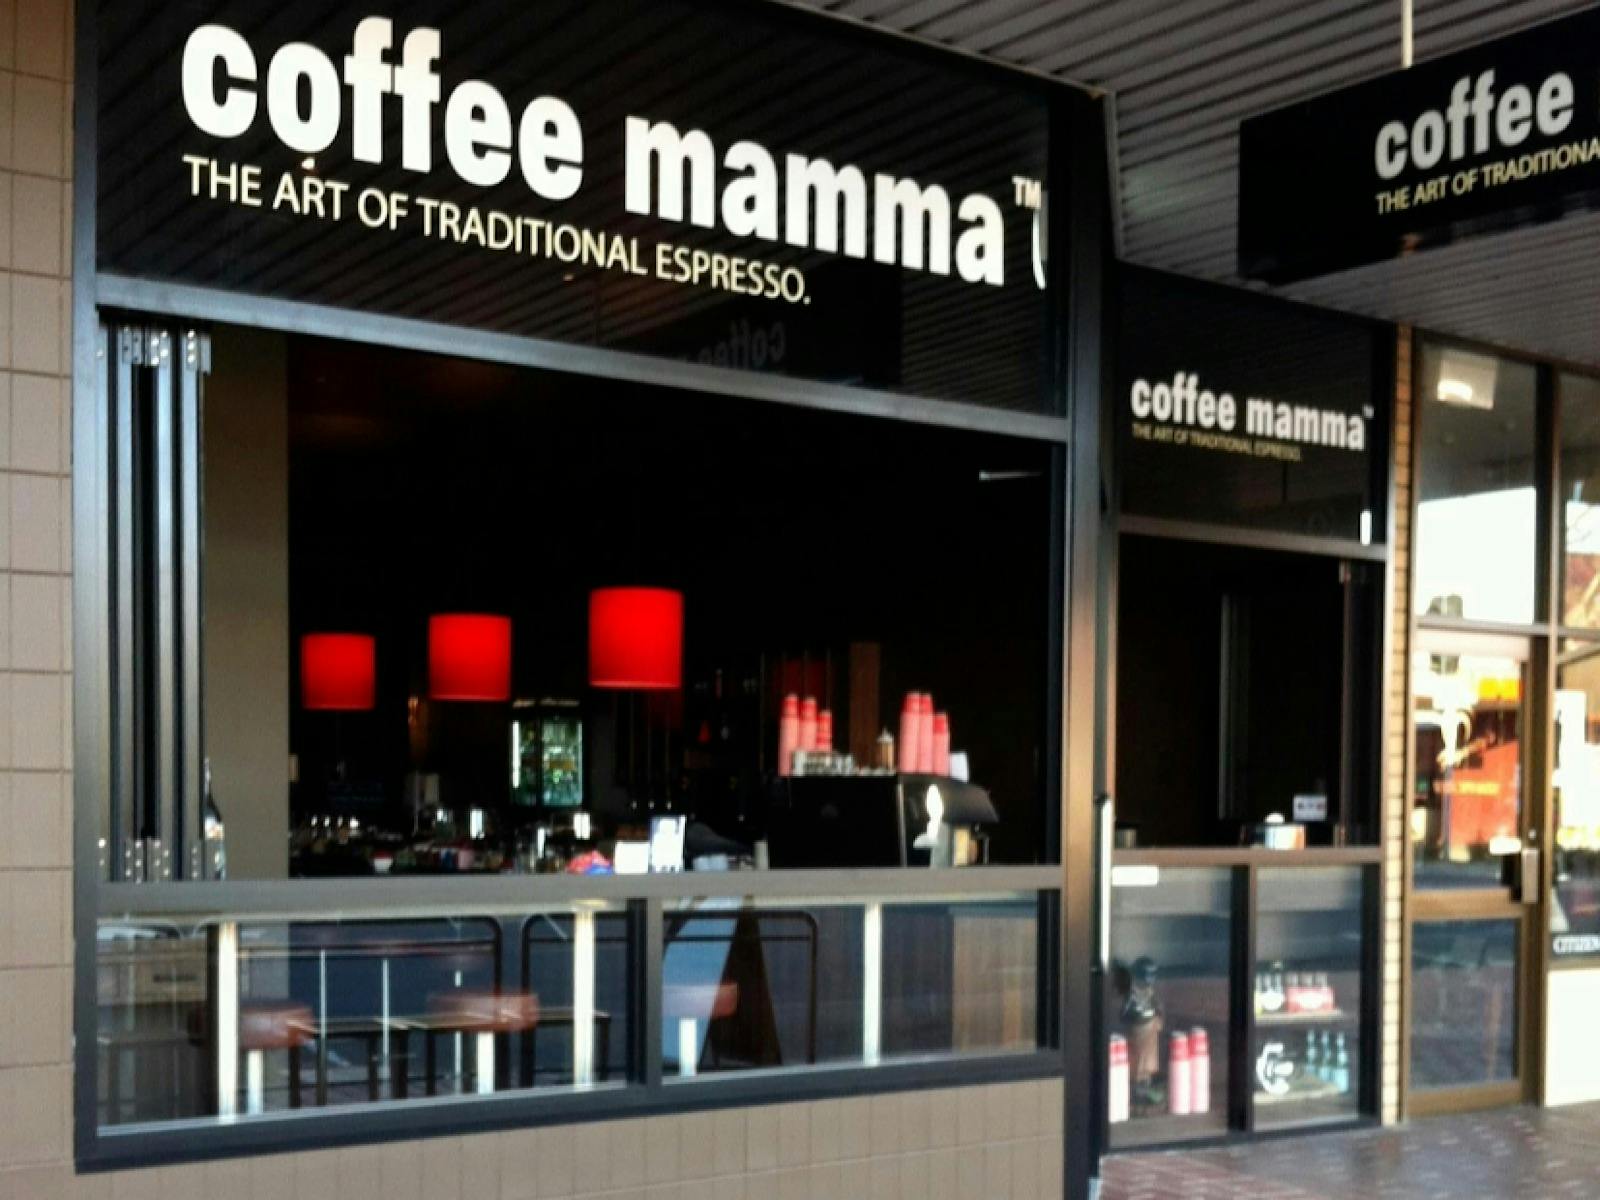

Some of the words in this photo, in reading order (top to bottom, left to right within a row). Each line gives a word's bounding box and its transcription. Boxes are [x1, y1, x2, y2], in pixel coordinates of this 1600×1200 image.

[181, 15, 584, 200] coffee
[625, 115, 1005, 286] mamma
[1374, 67, 1575, 180] coffee
[182, 154, 263, 207] THE
[272, 172, 349, 221] ART
[357, 187, 409, 231] OF
[415, 197, 648, 276] TRADITIONAL
[654, 243, 812, 305] ESPRESSO.
[1374, 186, 1411, 215] THE
[1414, 175, 1450, 206] ART
[1452, 167, 1479, 196] OF
[1131, 370, 1237, 431] coffee
[1245, 397, 1365, 451] mamma
